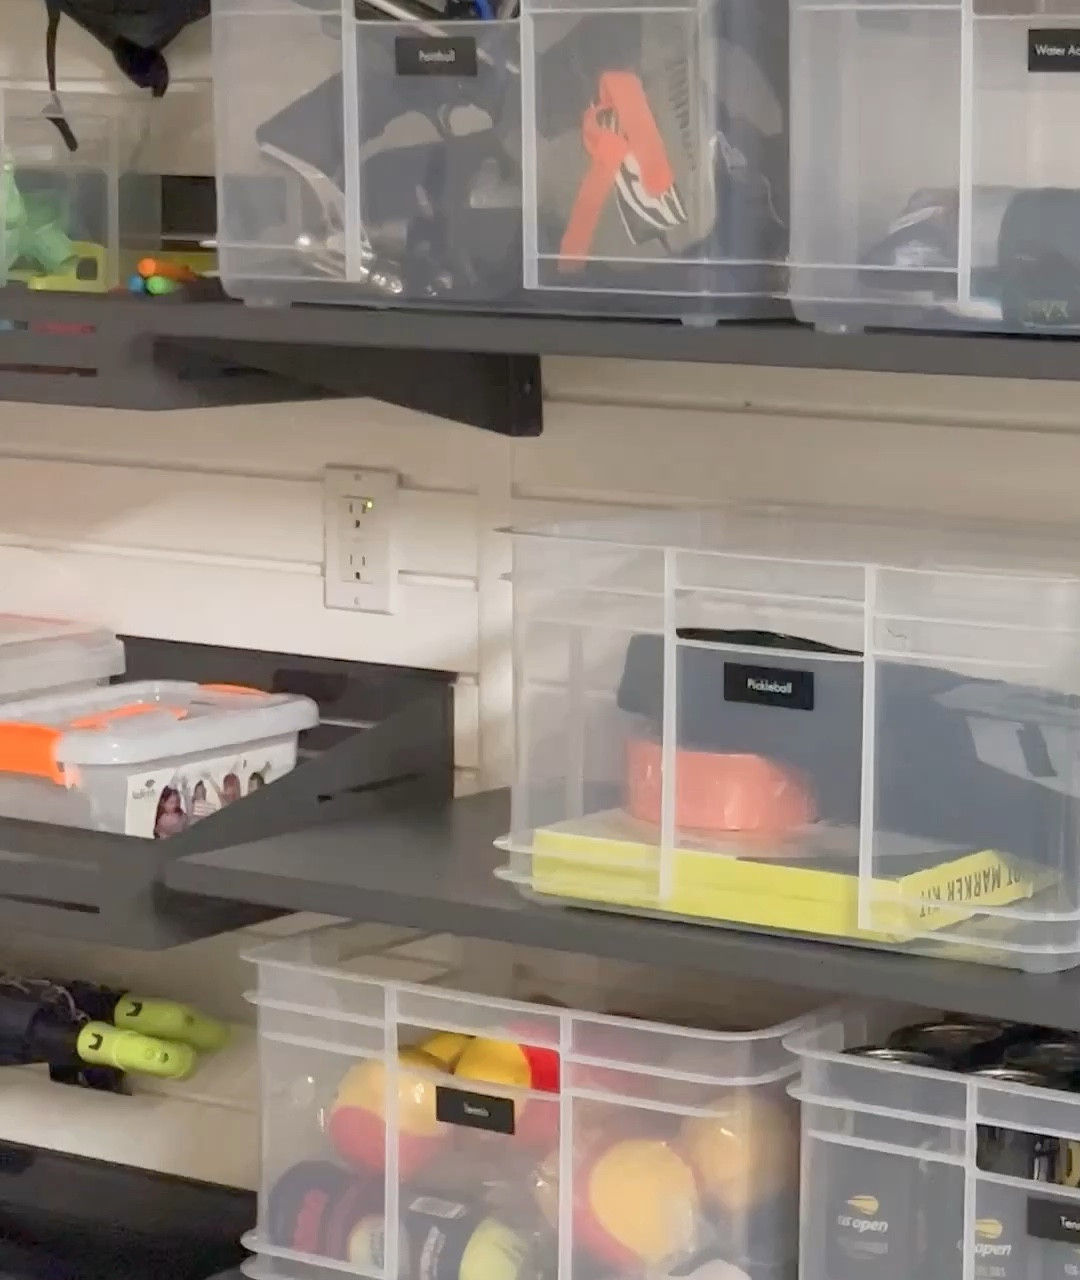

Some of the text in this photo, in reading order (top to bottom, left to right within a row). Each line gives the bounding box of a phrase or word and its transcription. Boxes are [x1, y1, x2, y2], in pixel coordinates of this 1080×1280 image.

[1034, 43, 1066, 57] Water
[747, 677, 793, 694] Pickleball
[947, 863, 1002, 901] MARKER
[852, 1220, 889, 1233] open
[973, 1243, 1012, 1257] open
